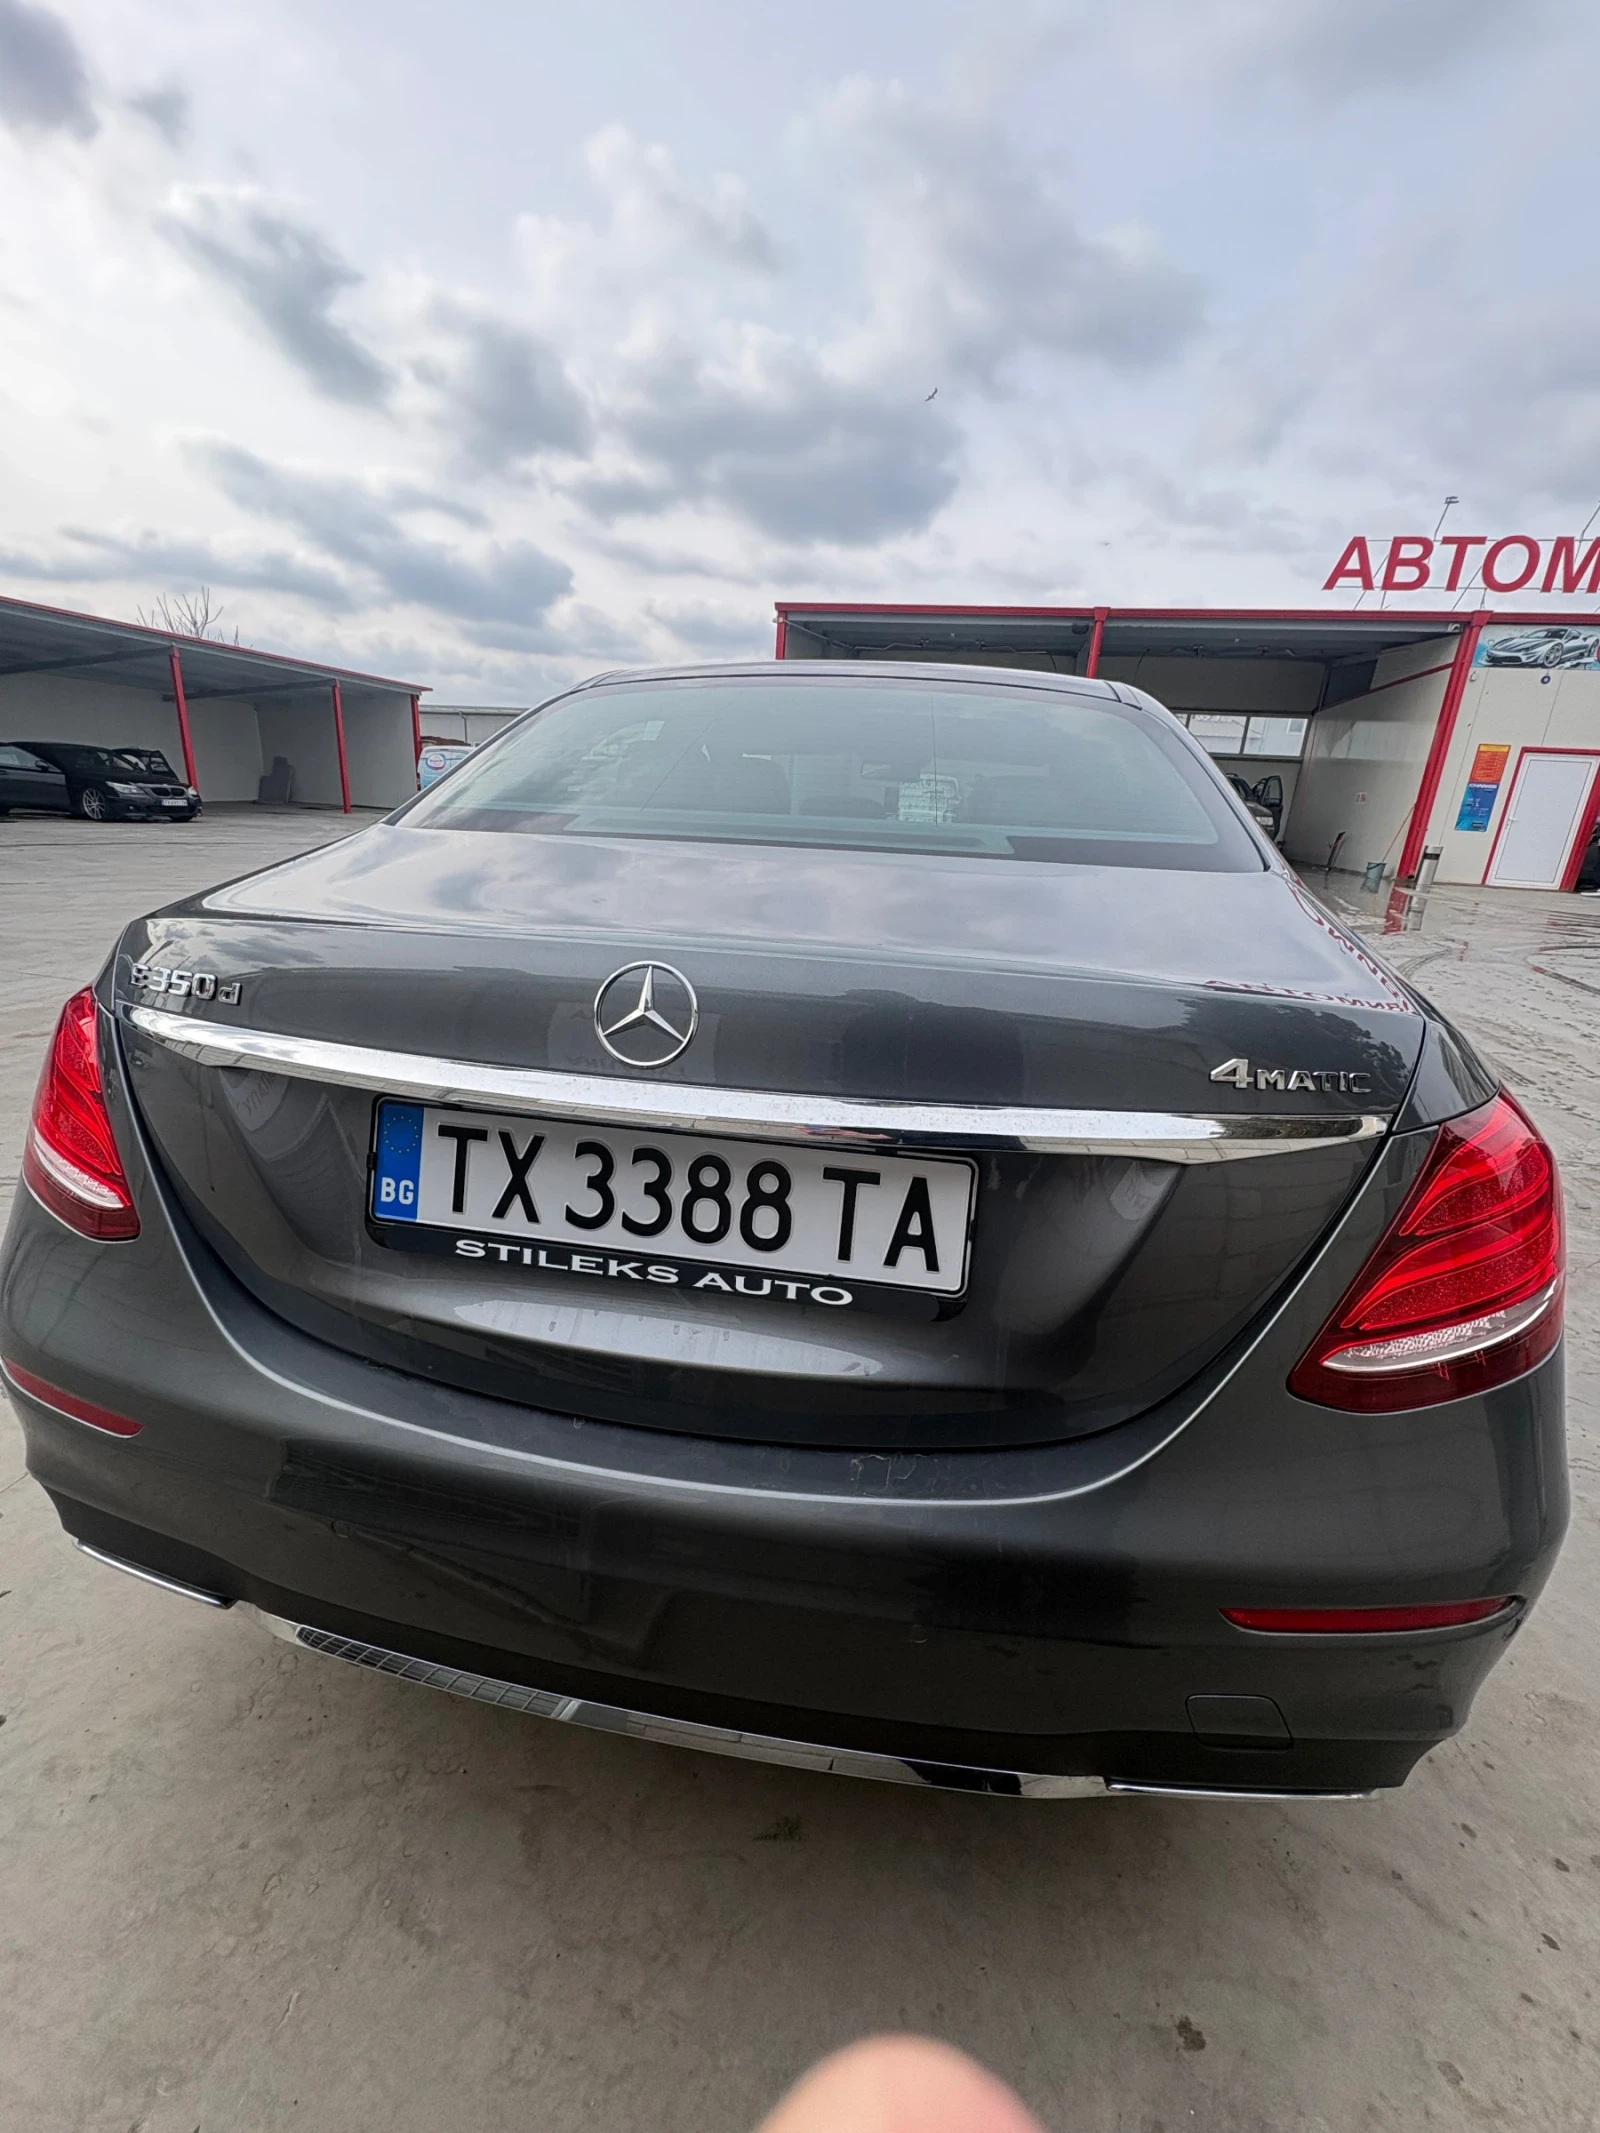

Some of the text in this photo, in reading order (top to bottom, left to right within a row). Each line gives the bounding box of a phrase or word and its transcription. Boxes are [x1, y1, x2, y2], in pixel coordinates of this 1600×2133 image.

[1321, 535, 1600, 593] АВТОМ
[1210, 1058, 1372, 1093] 4MATIC
[380, 1176, 415, 1206] BG
[437, 1122, 941, 1272] TX 3388 TA
[454, 1239, 853, 1307] STILEKS AUTO
